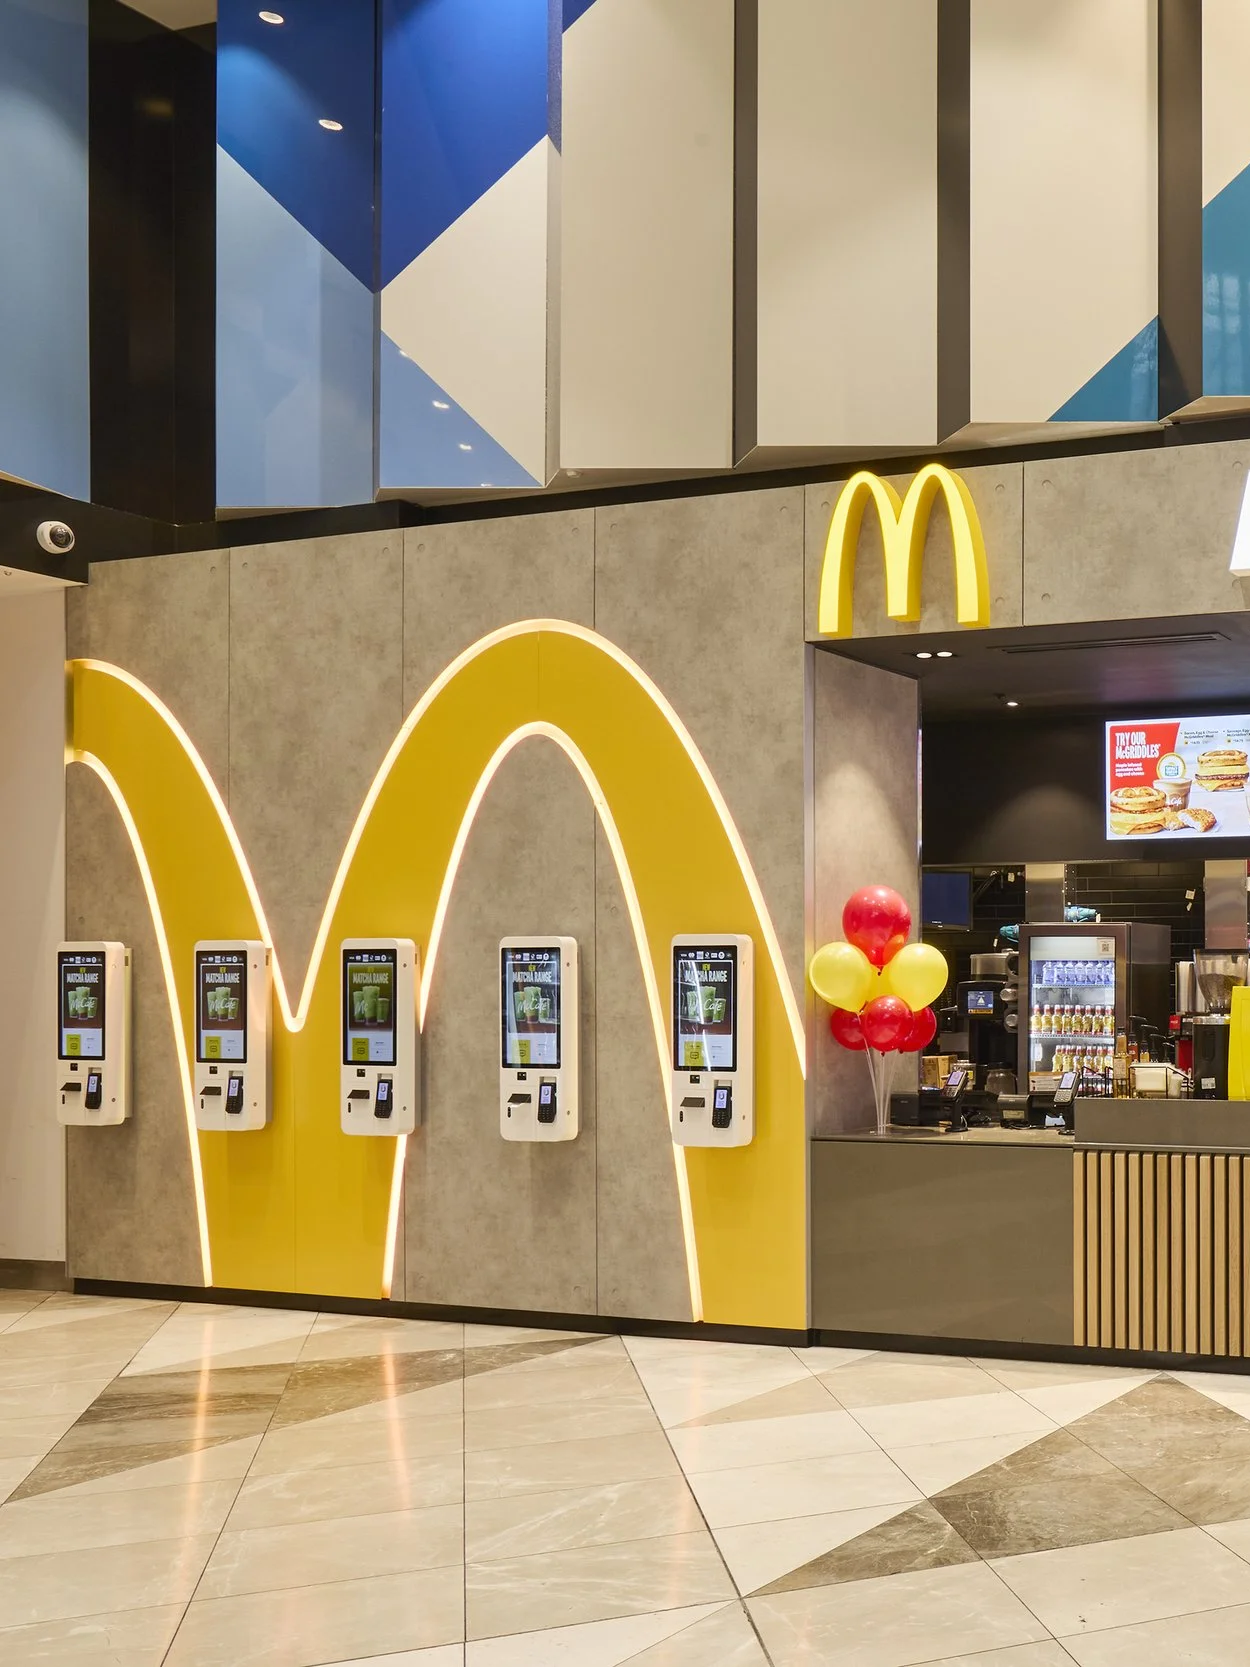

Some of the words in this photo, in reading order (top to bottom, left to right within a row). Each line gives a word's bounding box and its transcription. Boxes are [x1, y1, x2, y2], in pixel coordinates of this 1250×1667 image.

[1115, 732, 1130, 746] TRY
[1130, 731, 1146, 745] OUR
[708, 970, 728, 982] RANGE
